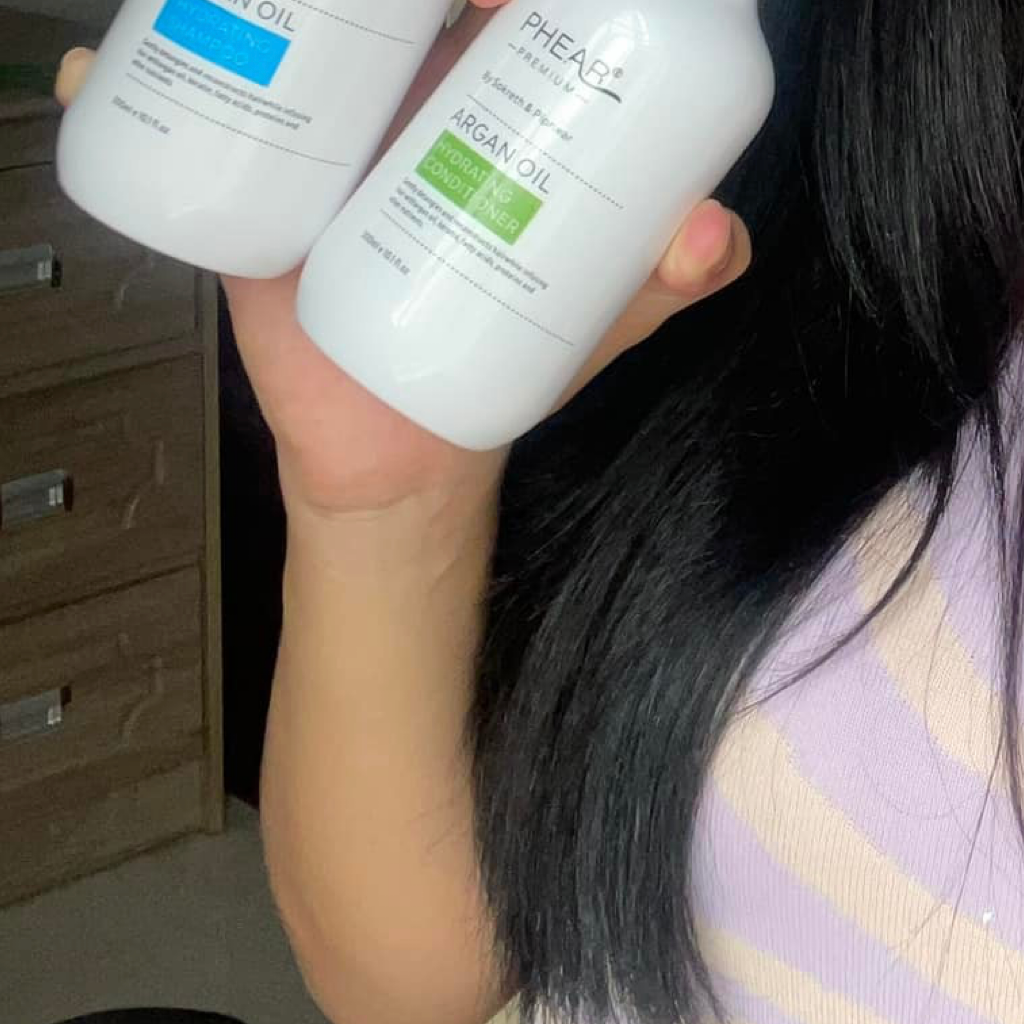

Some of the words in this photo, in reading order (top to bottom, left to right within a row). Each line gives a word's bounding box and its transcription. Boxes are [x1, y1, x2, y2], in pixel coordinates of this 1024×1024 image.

[256, 0, 295, 33] OIL
[516, 46, 575, 93] PREMIUM
[524, 103, 533, 113] &
[450, 107, 516, 164] ARGAN
[516, 157, 552, 195] OIL
